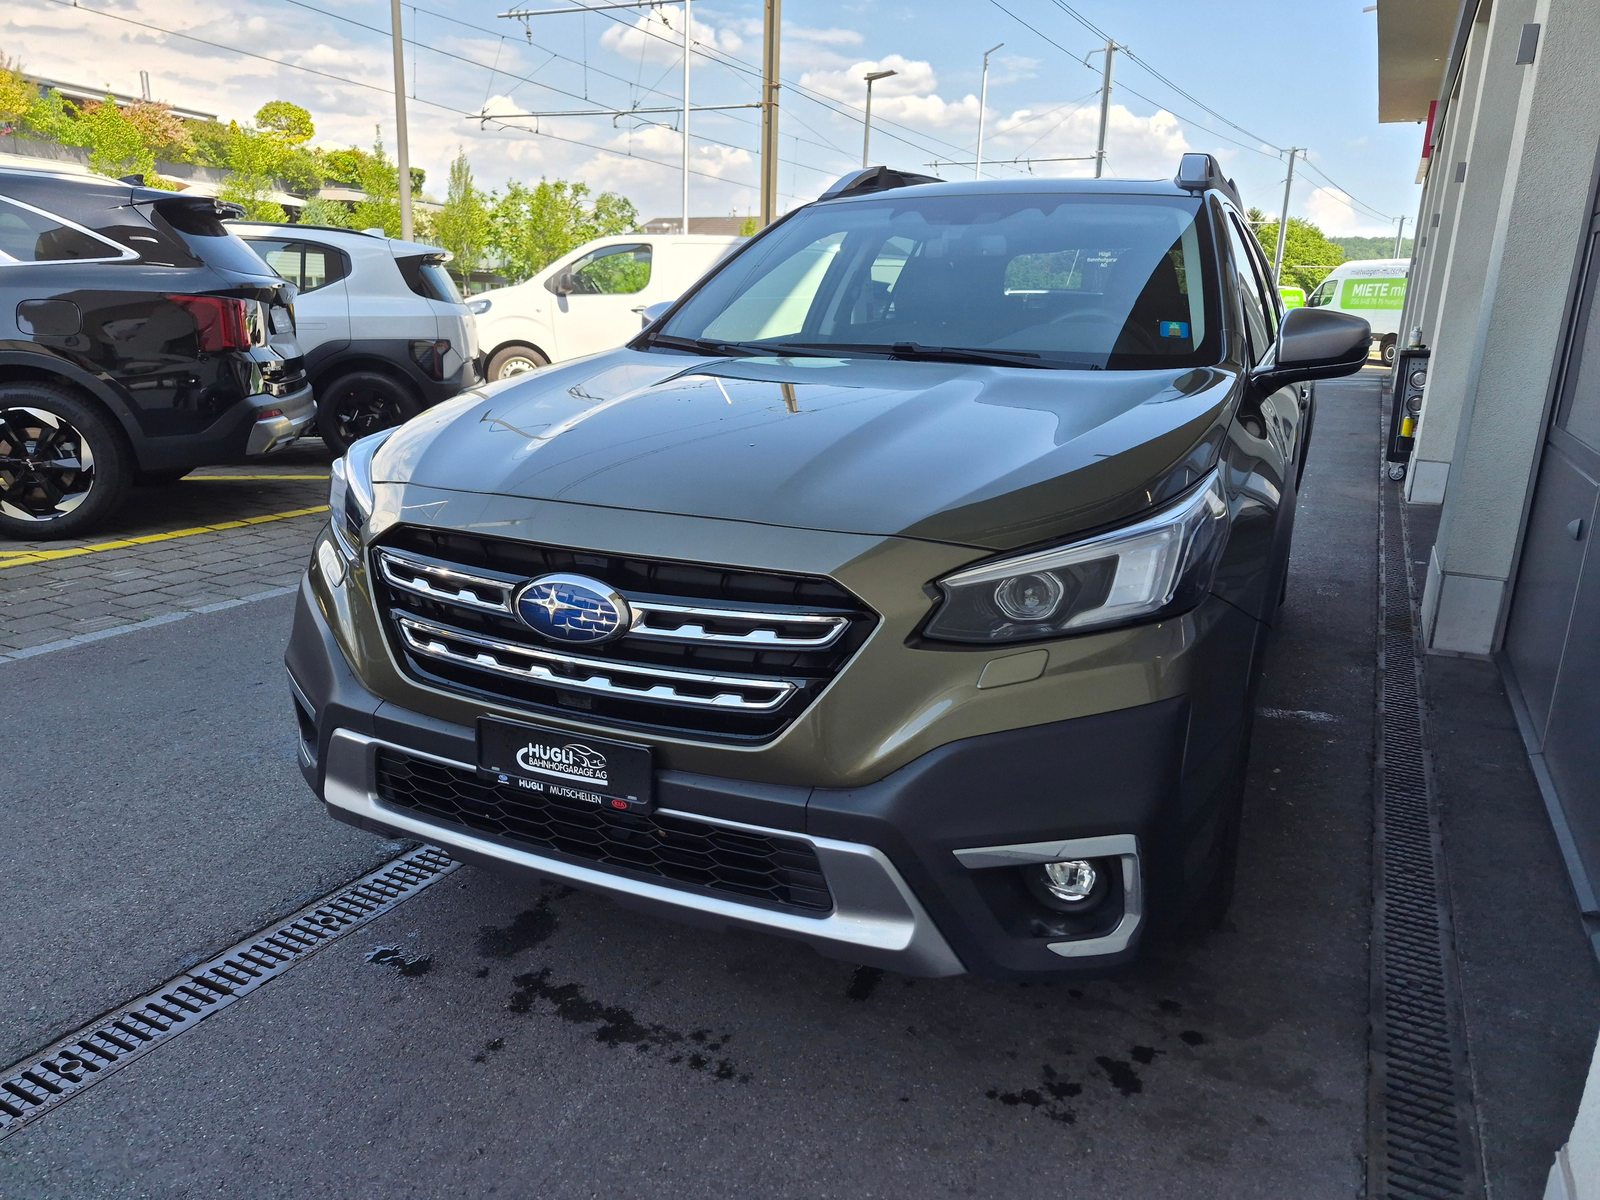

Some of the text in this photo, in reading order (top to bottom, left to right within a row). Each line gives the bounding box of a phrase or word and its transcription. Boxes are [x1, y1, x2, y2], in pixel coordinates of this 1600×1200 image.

[1352, 283, 1389, 297] MIETE
[529, 742, 573, 765] HÜGLI
[528, 757, 608, 779] BAHNHOFGARAGE AG
[549, 785, 602, 804] MUTSCHELLEN
